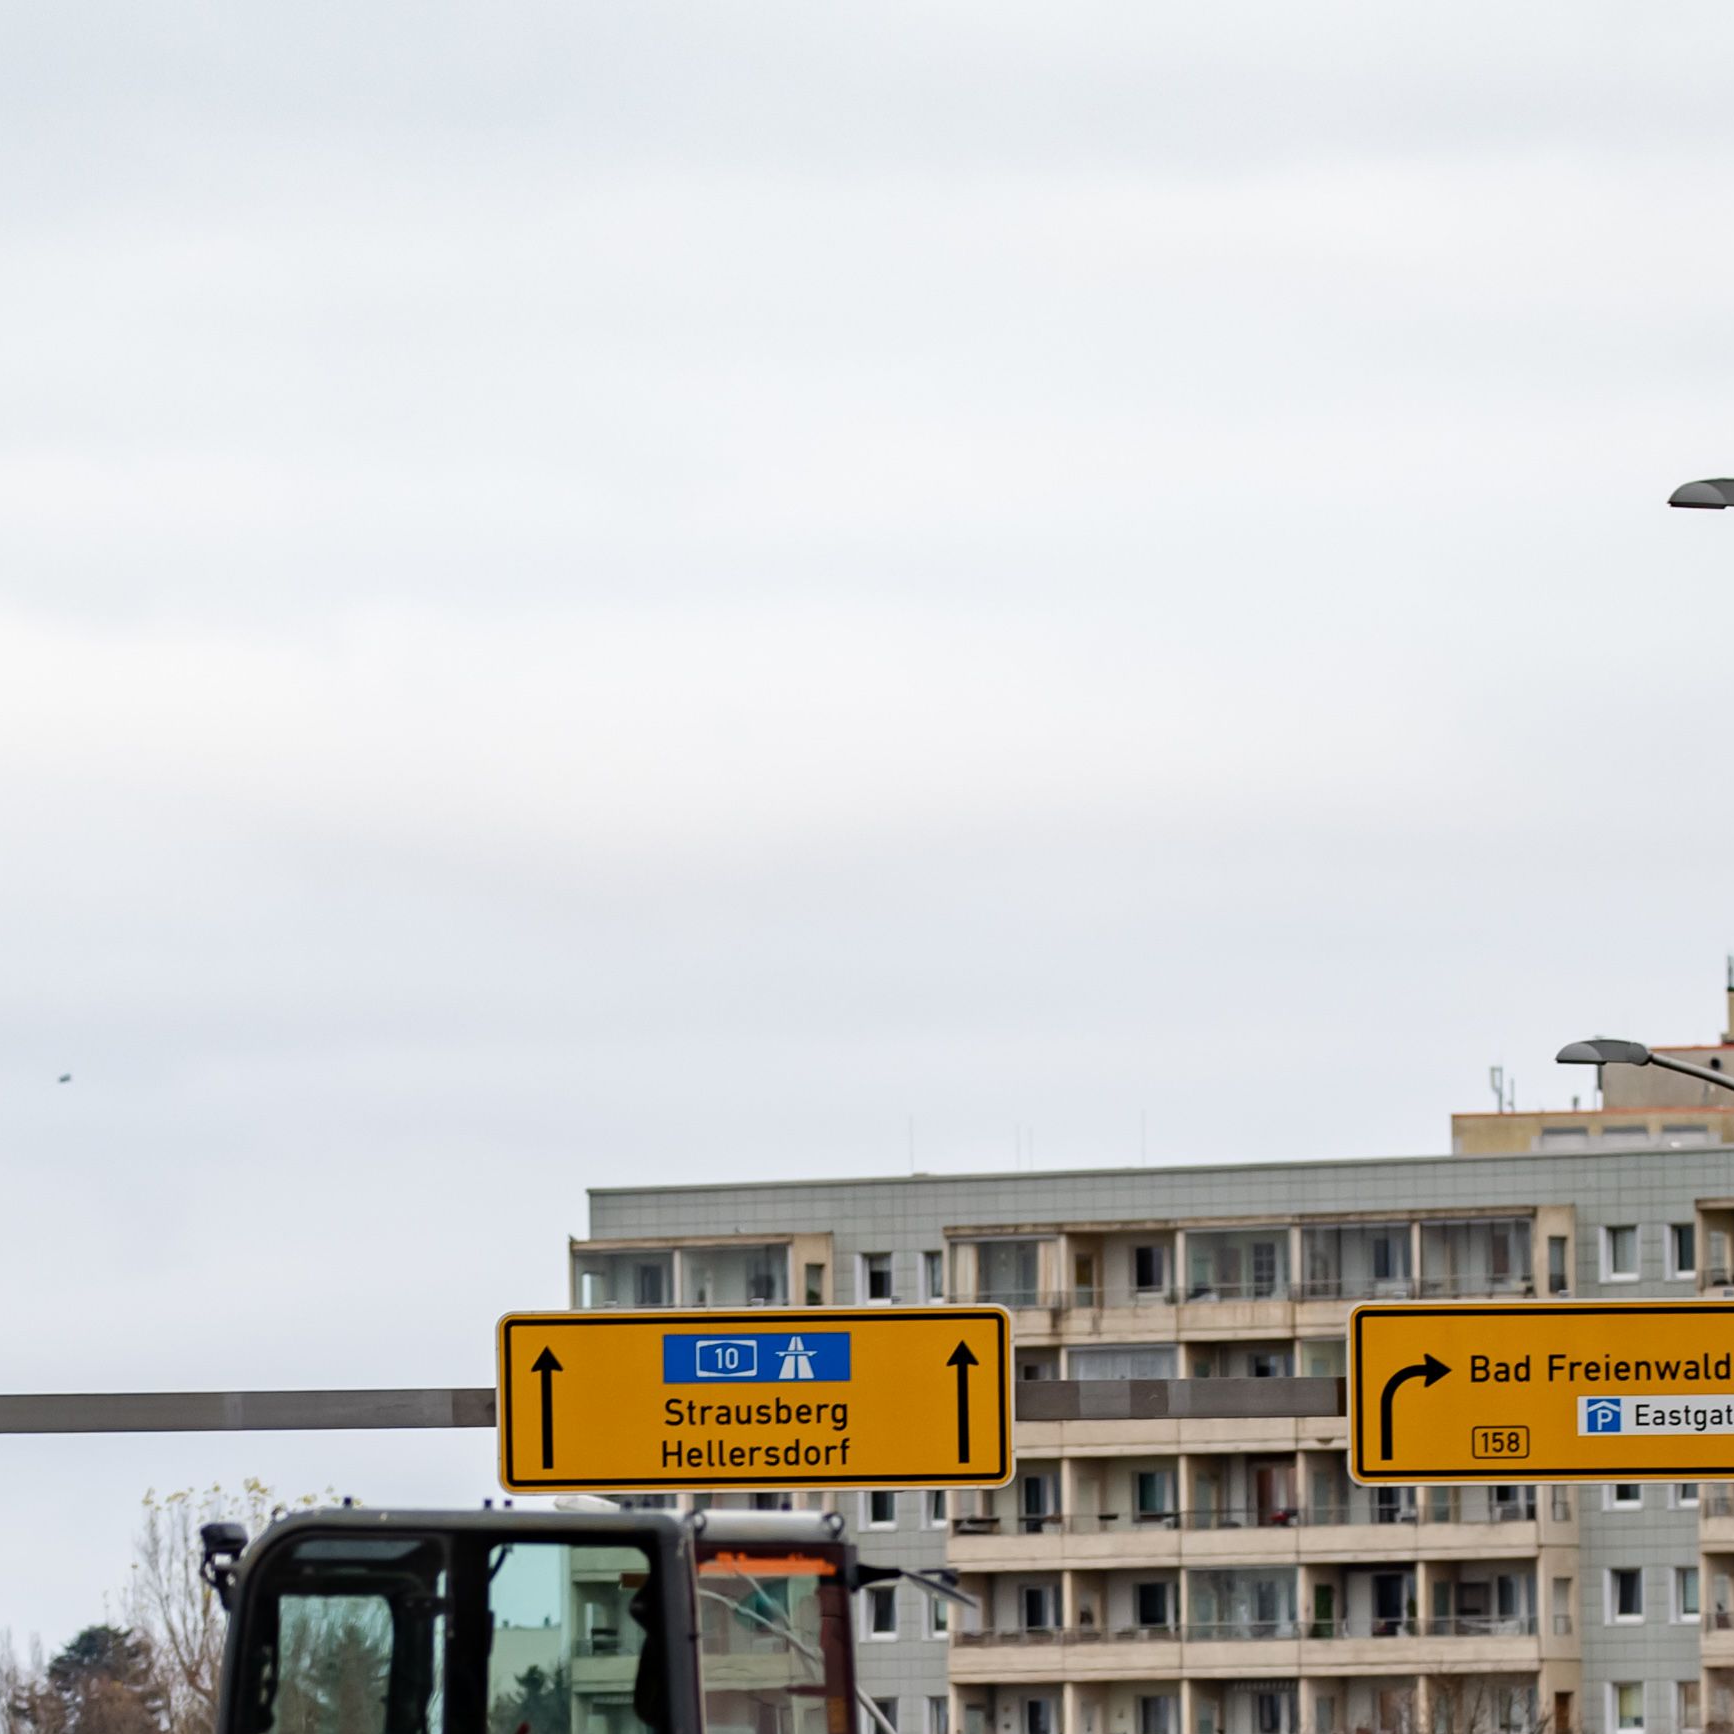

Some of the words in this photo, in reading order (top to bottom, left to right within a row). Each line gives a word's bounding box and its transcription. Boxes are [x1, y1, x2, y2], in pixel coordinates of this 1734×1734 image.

[714, 1347, 739, 1370] 10
[1470, 1354, 1532, 1383] Bad
[663, 1396, 850, 1431] Strausberg
[661, 1437, 852, 1468] Hellersdorf
[1480, 1431, 1521, 1454] 158
